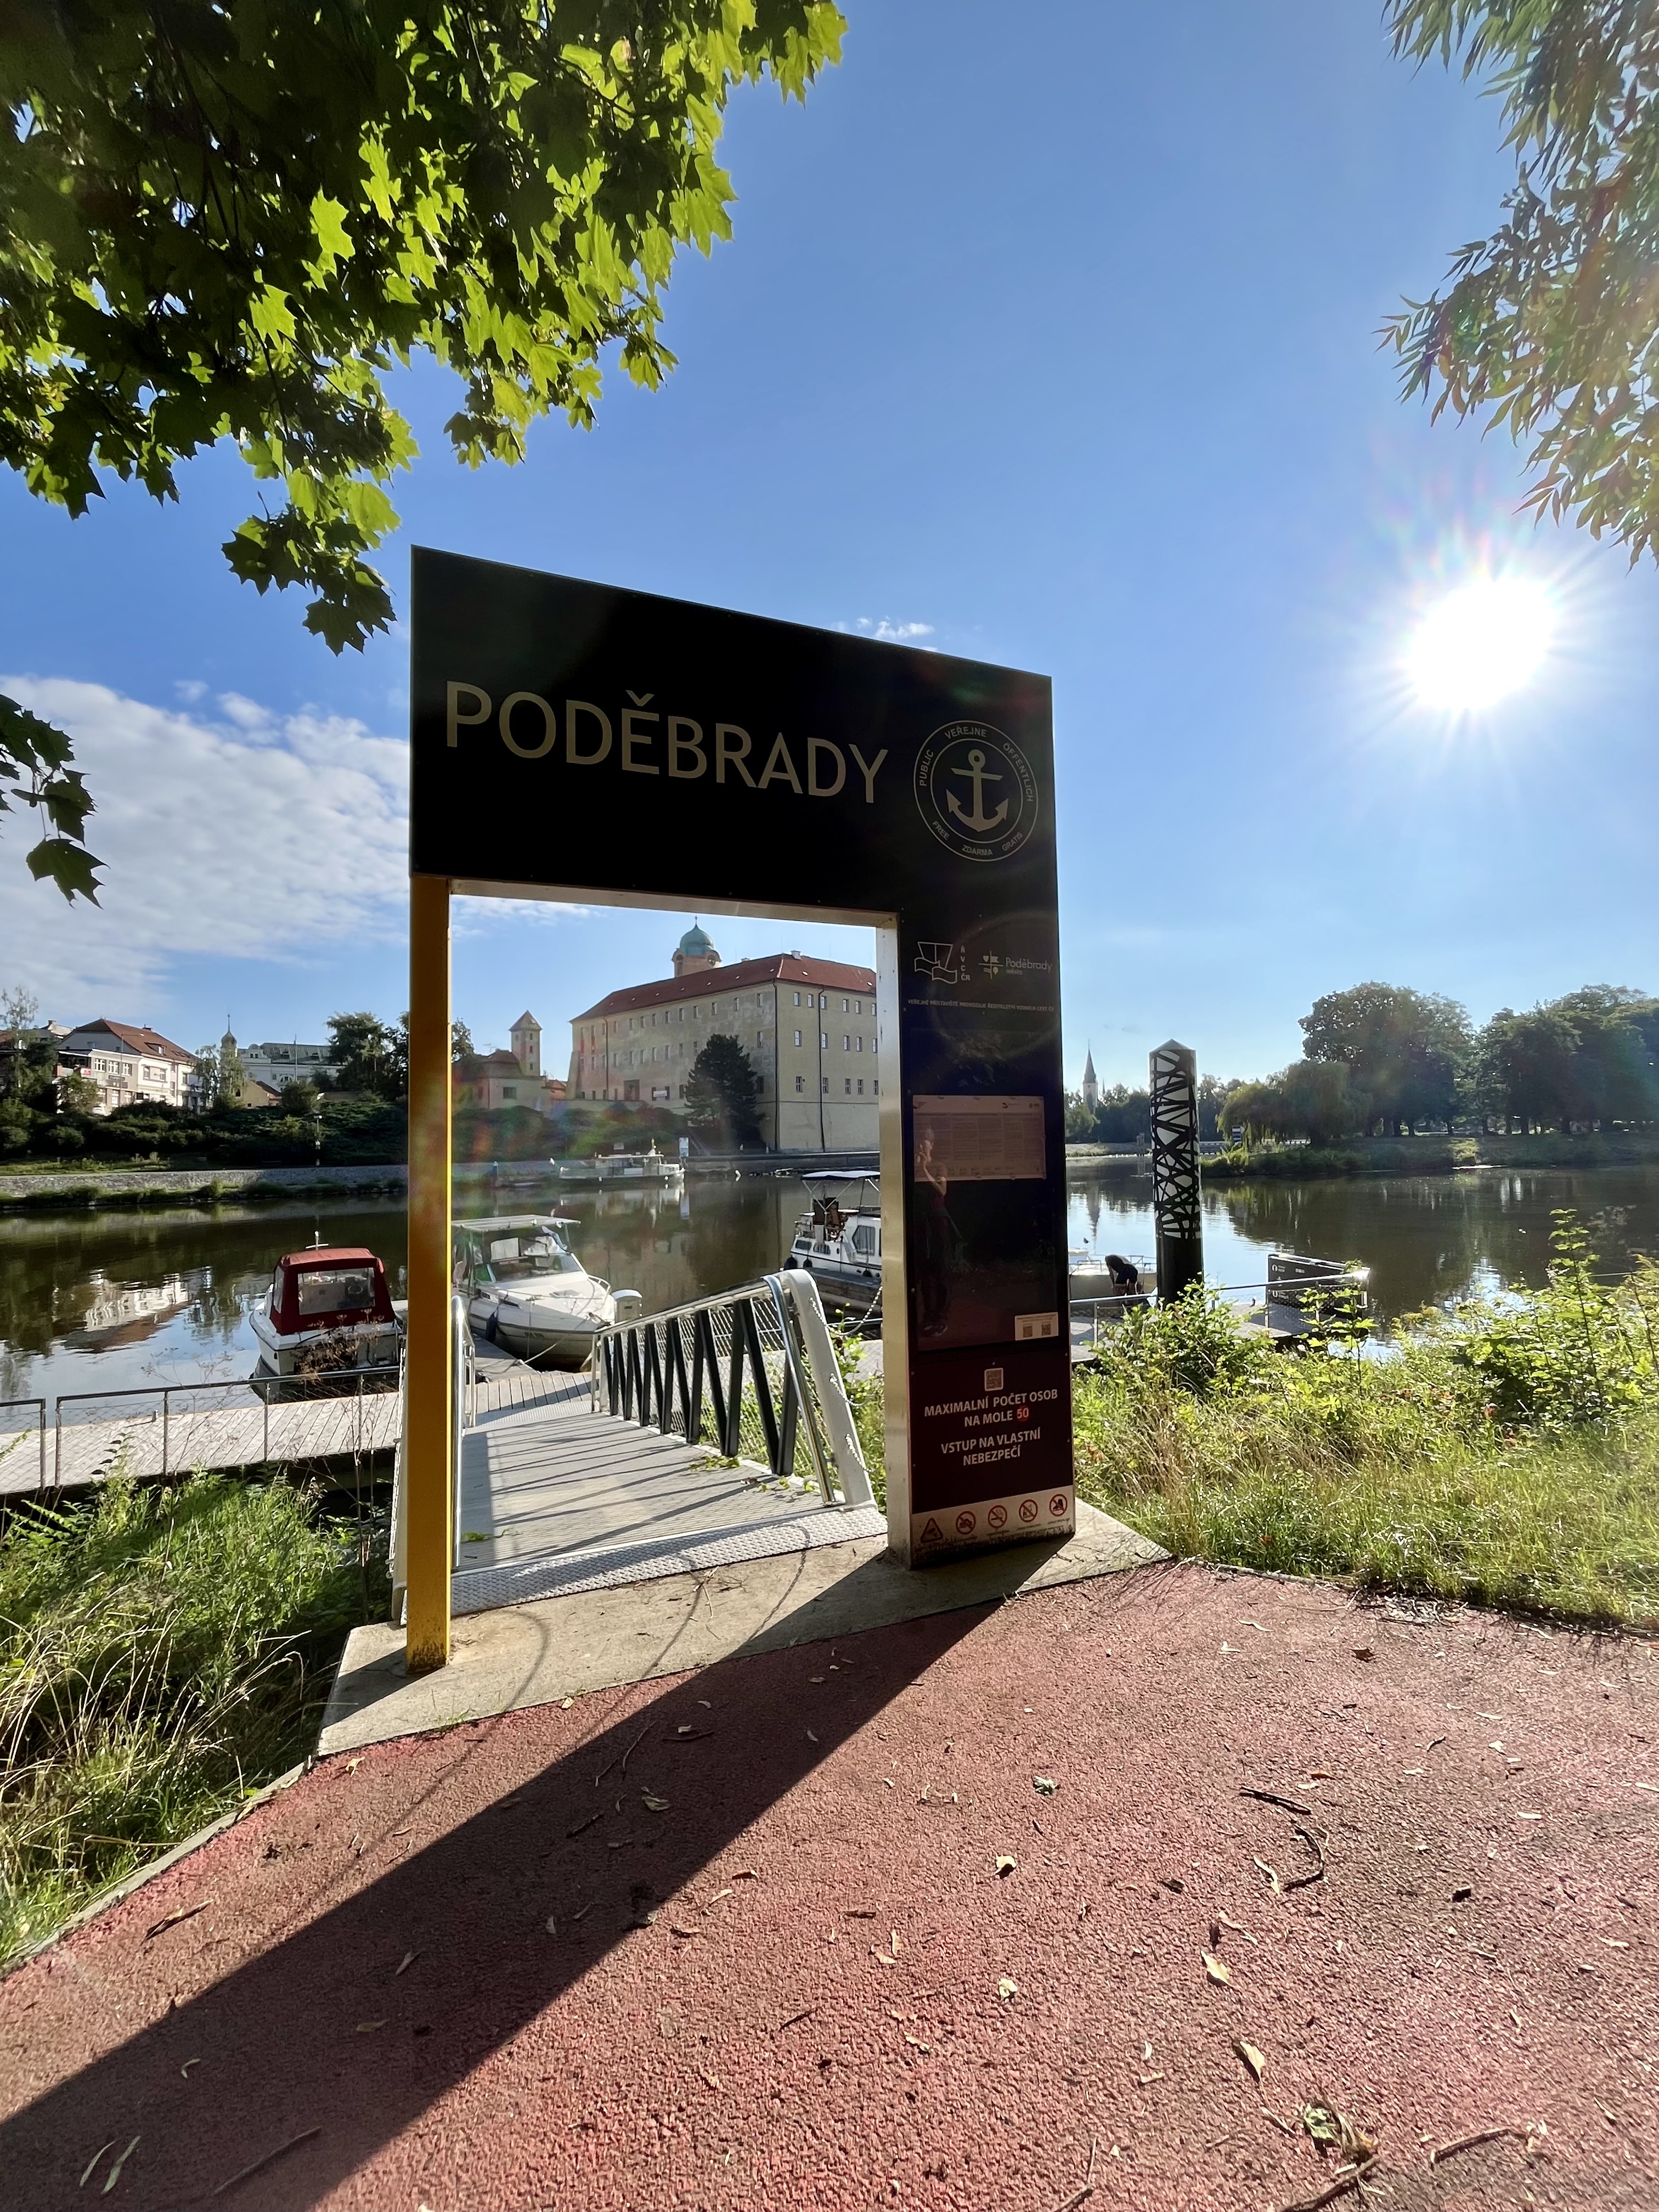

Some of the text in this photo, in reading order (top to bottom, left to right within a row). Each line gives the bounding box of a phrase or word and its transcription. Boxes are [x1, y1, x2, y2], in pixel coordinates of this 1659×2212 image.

[445, 681, 889, 804] PODĚBRADY
[919, 749, 934, 786] PUBLIC
[933, 821, 950, 840] FREE
[962, 844, 993, 856] ZDARMA
[1002, 832, 1023, 851] GRATIS
[1005, 957, 1052, 973] Poděbrady
[924, 1389, 1058, 1417] MAXIMALNÍ POČET OSOB
[964, 1407, 1030, 1427] NA MOLE 50
[941, 1427, 1041, 1454] VSTUP NA VLASTNÍ
[963, 1445, 1020, 1466] NEBEZPEČÍ
